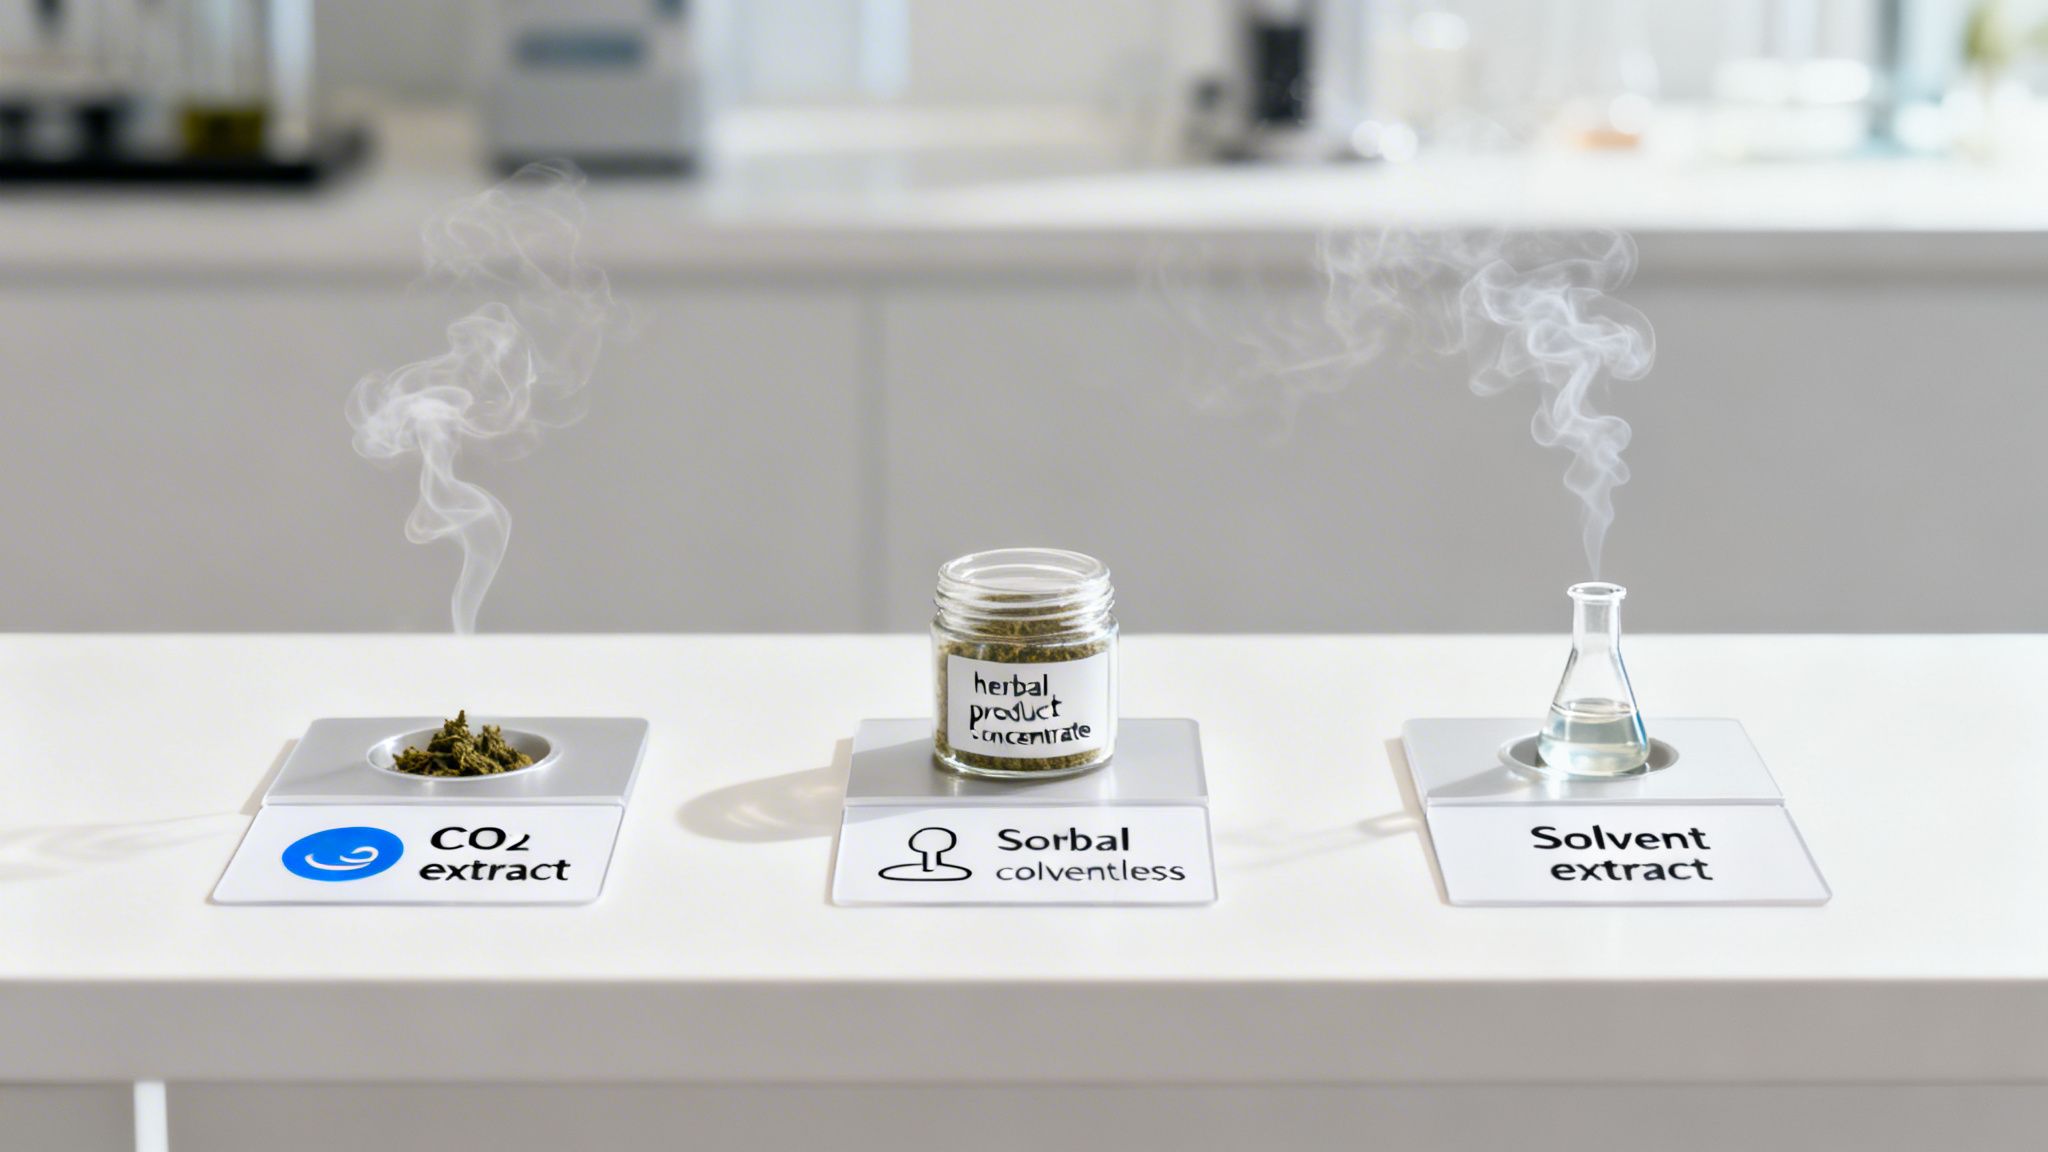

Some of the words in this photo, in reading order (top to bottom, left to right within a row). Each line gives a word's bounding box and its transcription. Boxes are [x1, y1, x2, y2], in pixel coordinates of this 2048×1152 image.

[974, 671, 1048, 697] herbal
[969, 694, 1062, 731] product
[997, 827, 1129, 852] Sorbal
[1530, 824, 1711, 850] Solvent
[419, 859, 571, 881] extract
[996, 859, 1186, 882] colventless
[1550, 859, 1713, 882] extract
